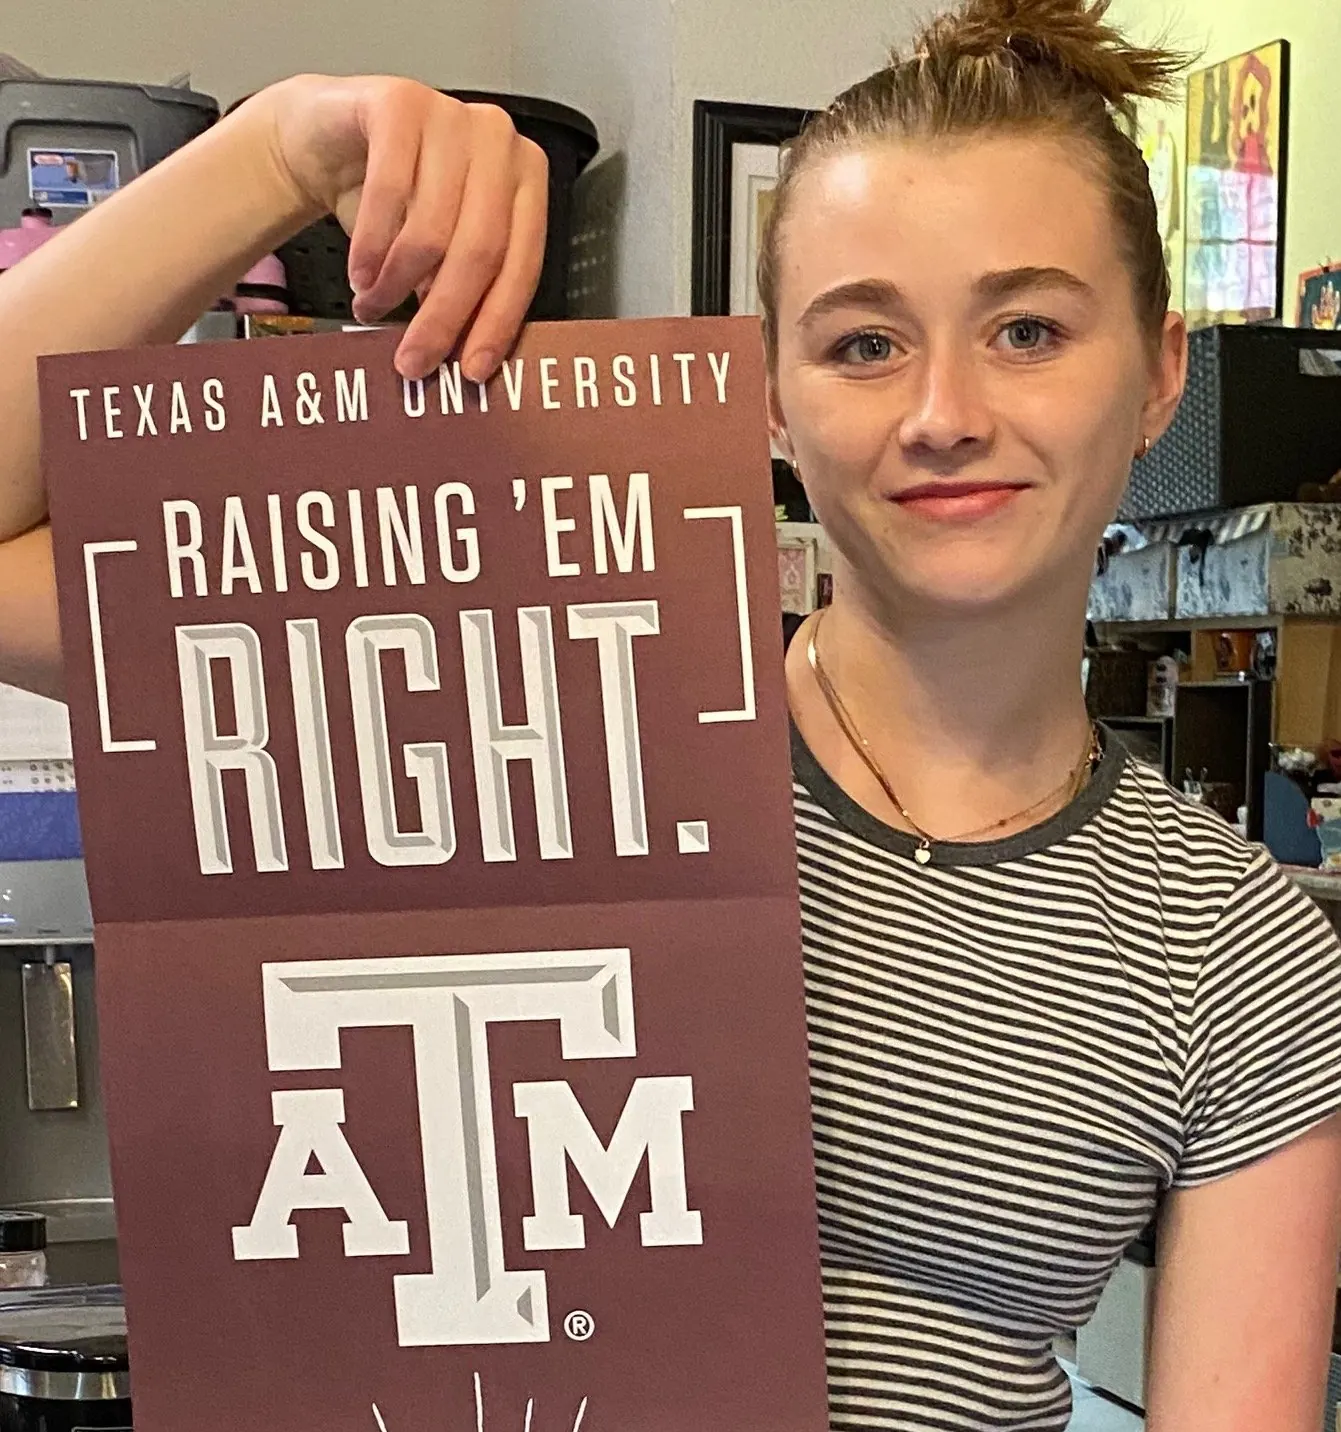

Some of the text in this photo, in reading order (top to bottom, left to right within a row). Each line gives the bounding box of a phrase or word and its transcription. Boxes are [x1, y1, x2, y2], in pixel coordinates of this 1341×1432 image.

[69, 351, 730, 441] TEXAS A&M UNIVERSITY
[162, 472, 656, 598] RAISING 'EM
[174, 599, 710, 875] RIGHT.
